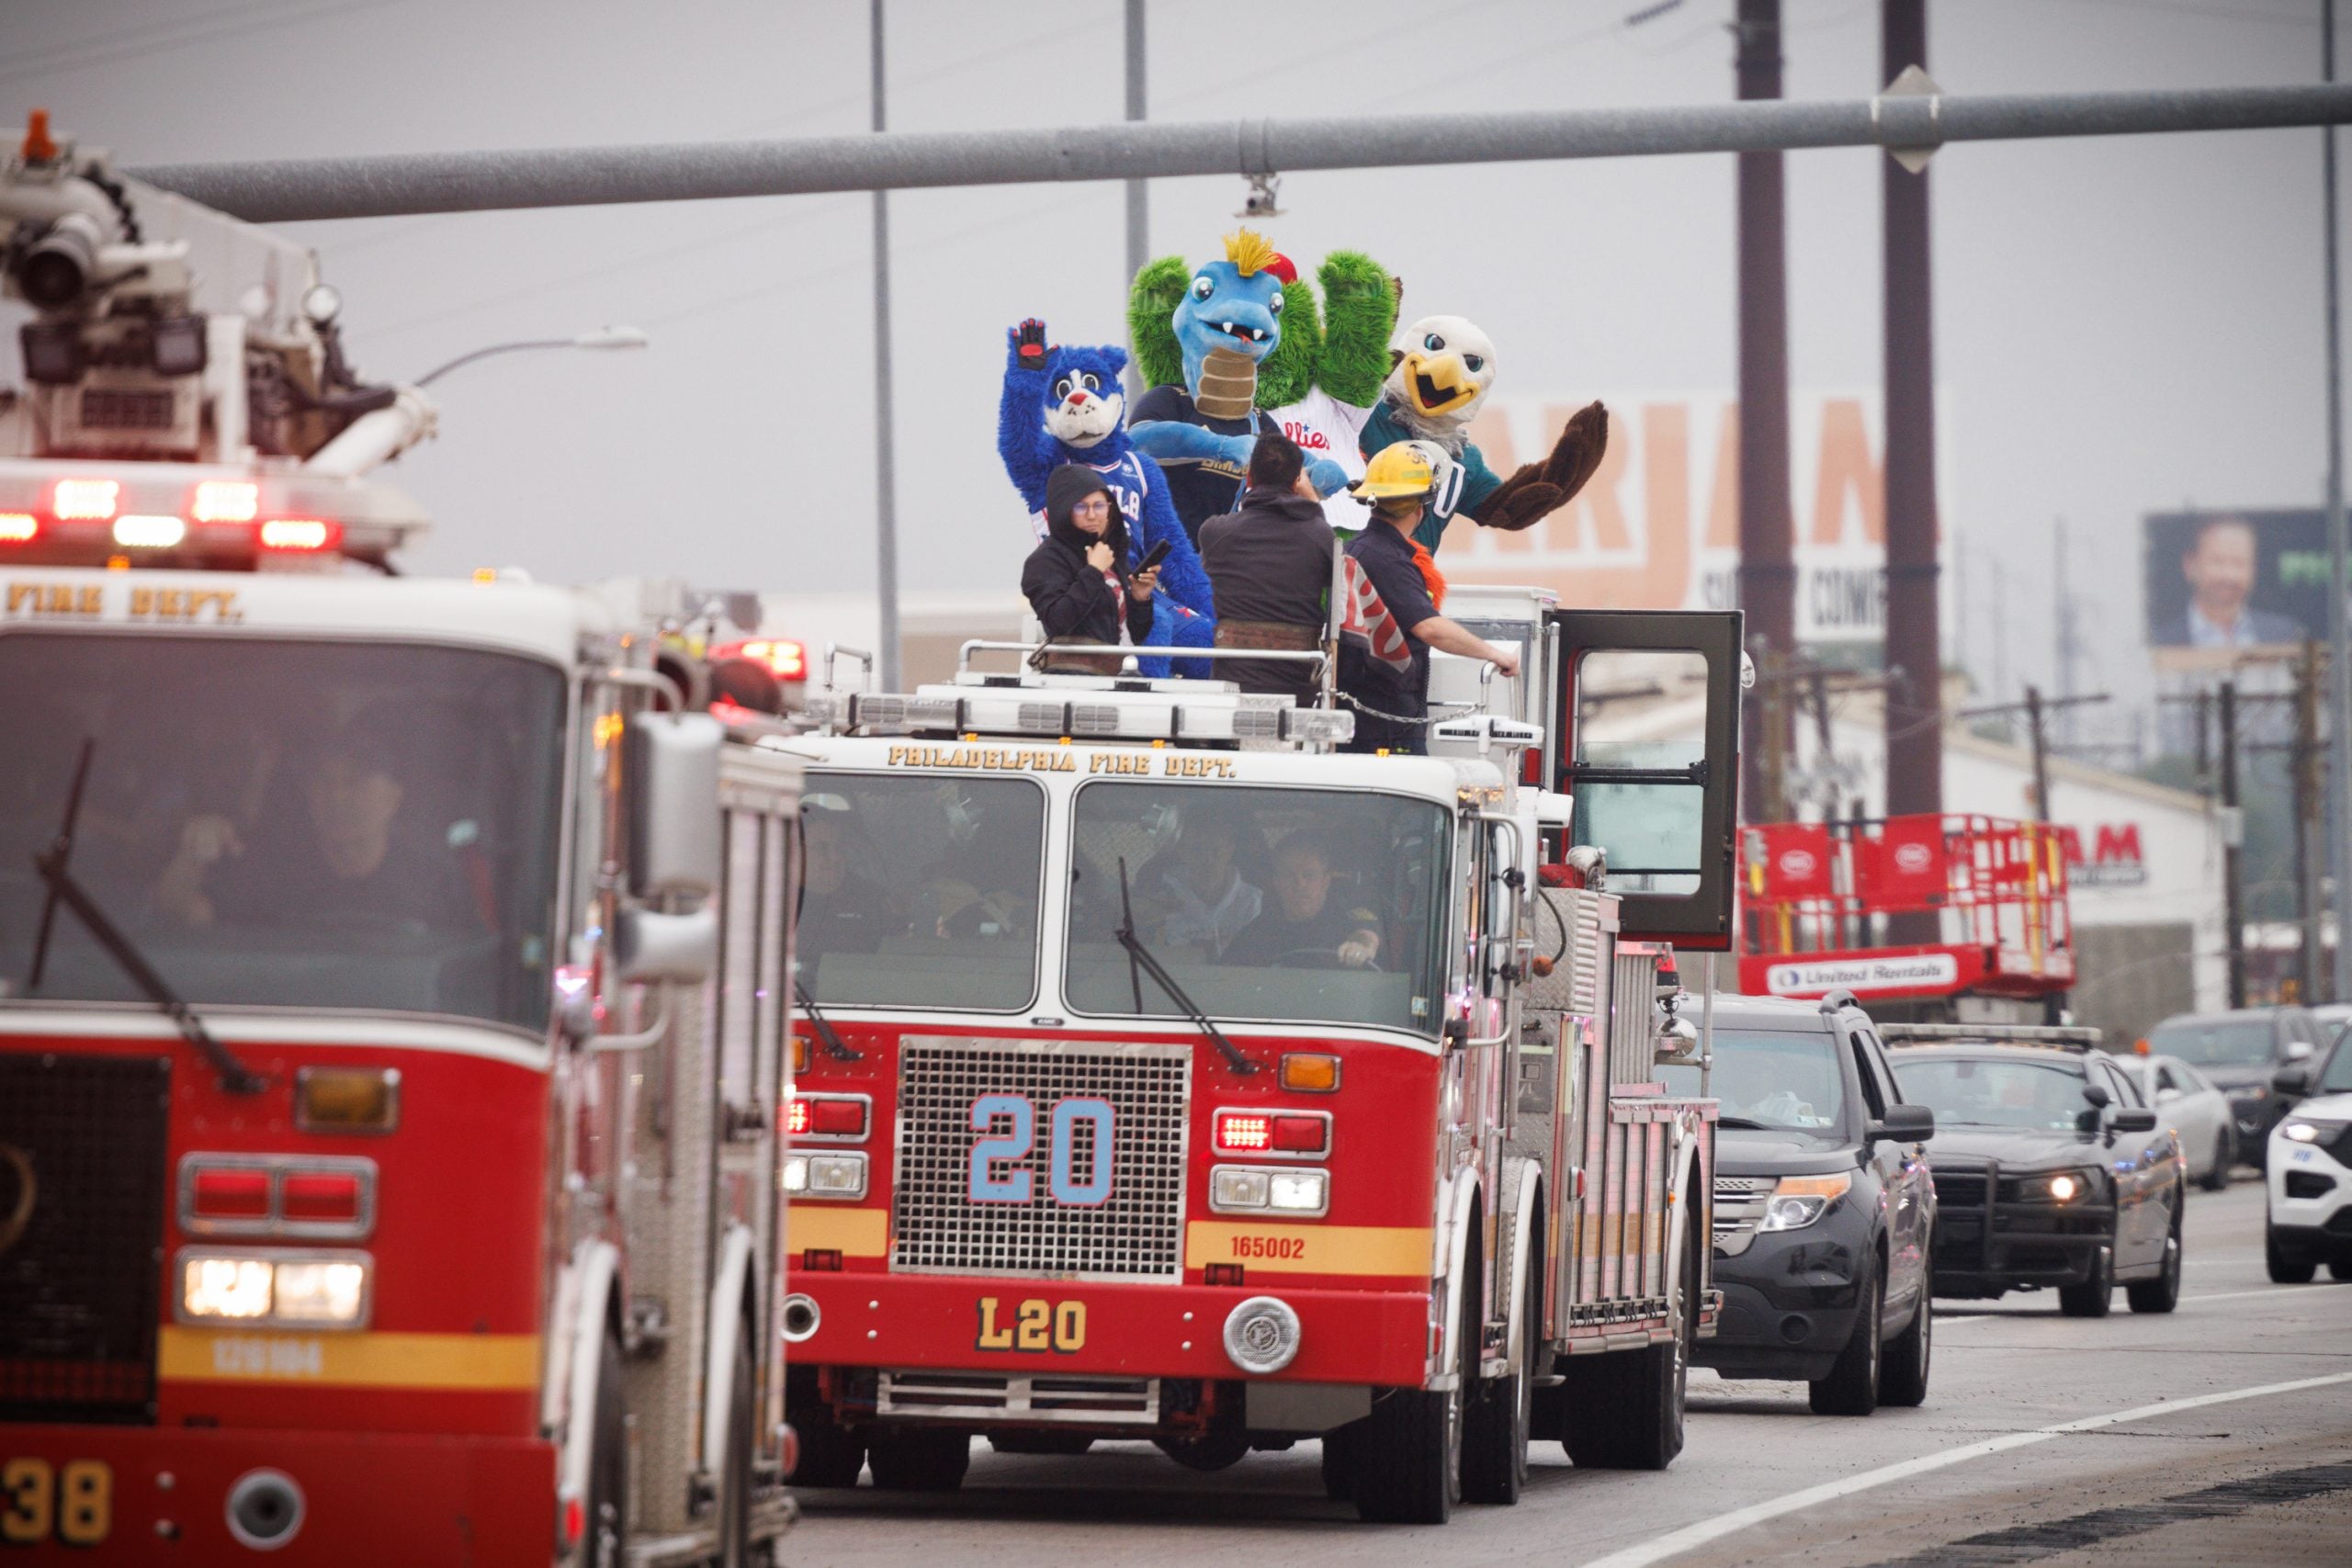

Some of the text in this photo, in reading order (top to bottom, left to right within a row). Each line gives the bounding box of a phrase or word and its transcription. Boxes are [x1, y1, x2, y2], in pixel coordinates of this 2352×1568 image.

[7, 582, 103, 613] FIRE
[888, 746, 1238, 779] PHILADELPHIA FIRE DEPT.
[967, 1093, 1116, 1207] 20
[1231, 1235, 1306, 1259] 165002
[976, 1296, 1087, 1354] L20
